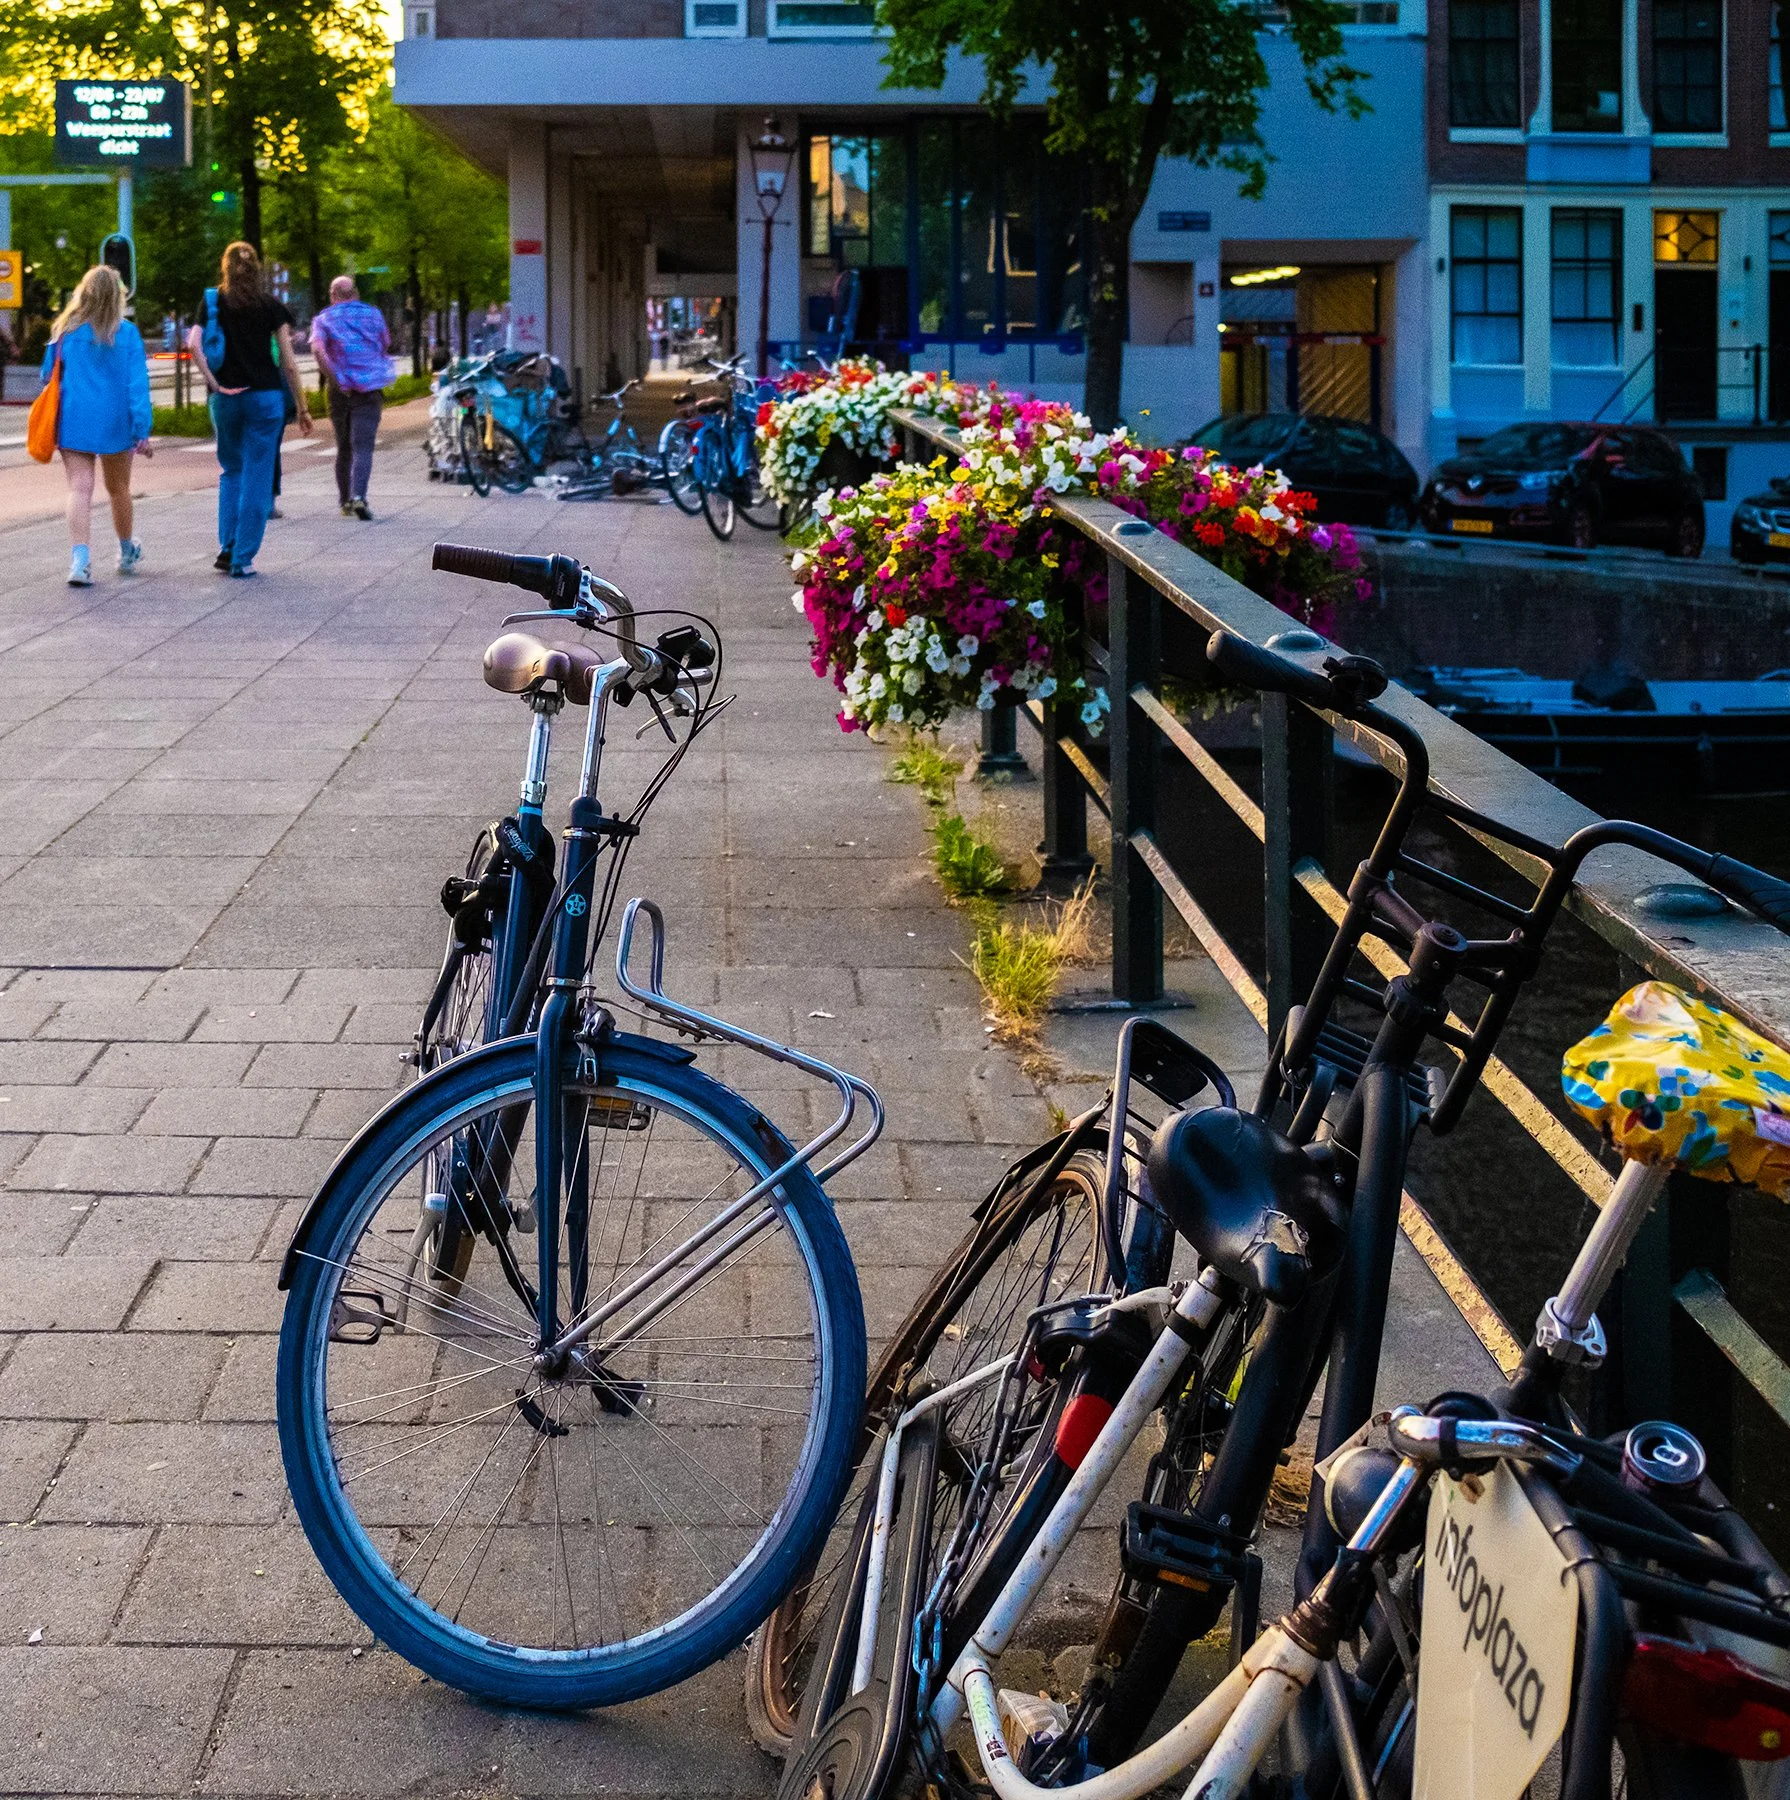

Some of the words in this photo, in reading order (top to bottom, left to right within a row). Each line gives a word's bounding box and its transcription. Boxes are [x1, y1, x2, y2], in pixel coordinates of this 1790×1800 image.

[65, 121, 172, 139] Weesperstraat
[99, 138, 139, 155] dicht
[1435, 1514, 1545, 1740] infoplaza
